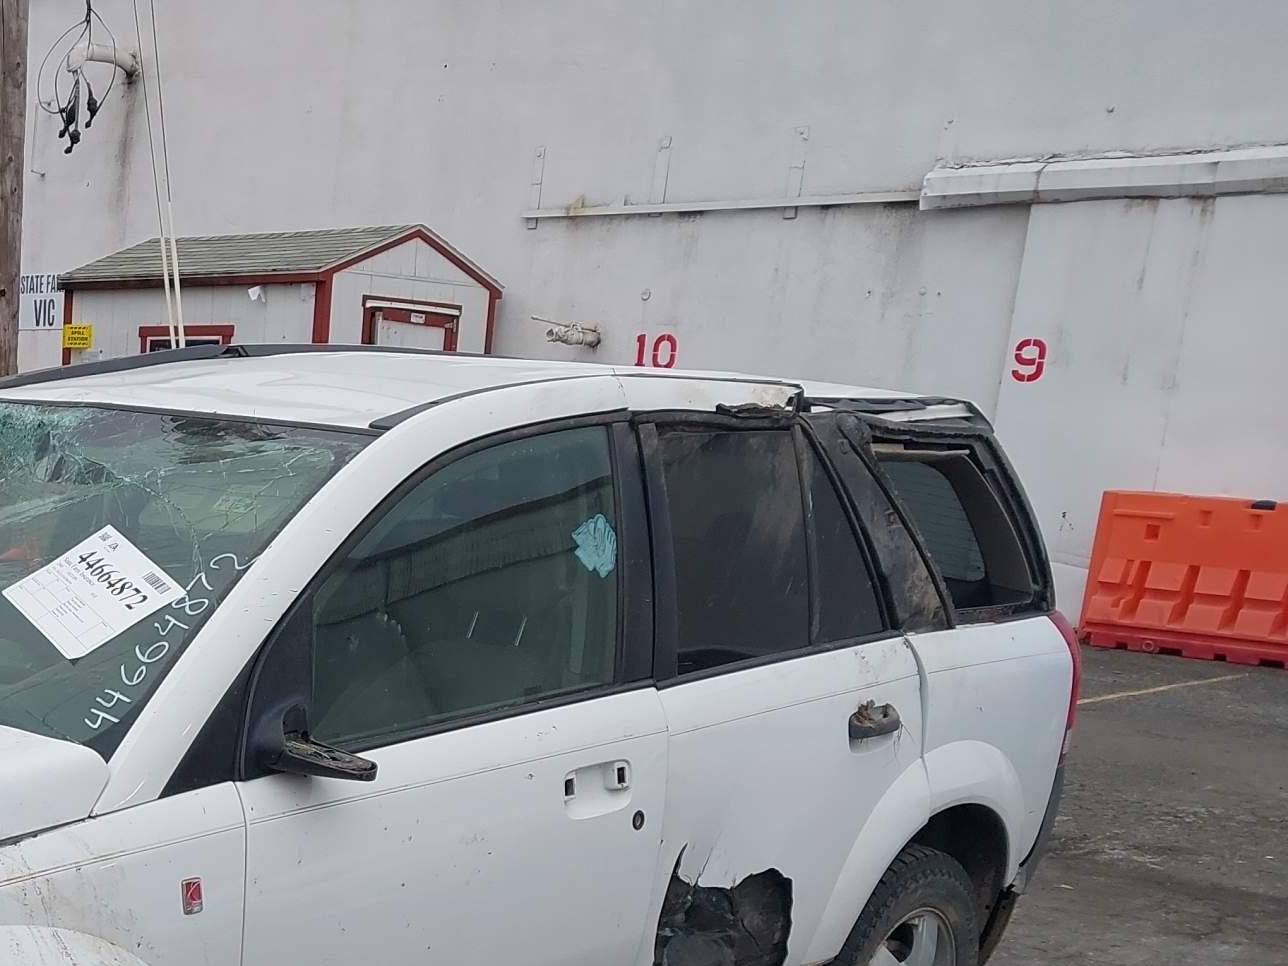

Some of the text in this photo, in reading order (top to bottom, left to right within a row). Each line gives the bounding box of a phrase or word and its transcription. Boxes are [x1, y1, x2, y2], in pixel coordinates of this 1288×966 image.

[21, 275, 44, 294] STATE
[33, 298, 55, 327] VIC
[634, 333, 678, 369] 10
[1011, 338, 1047, 383] 9
[78, 551, 149, 611] 44664872
